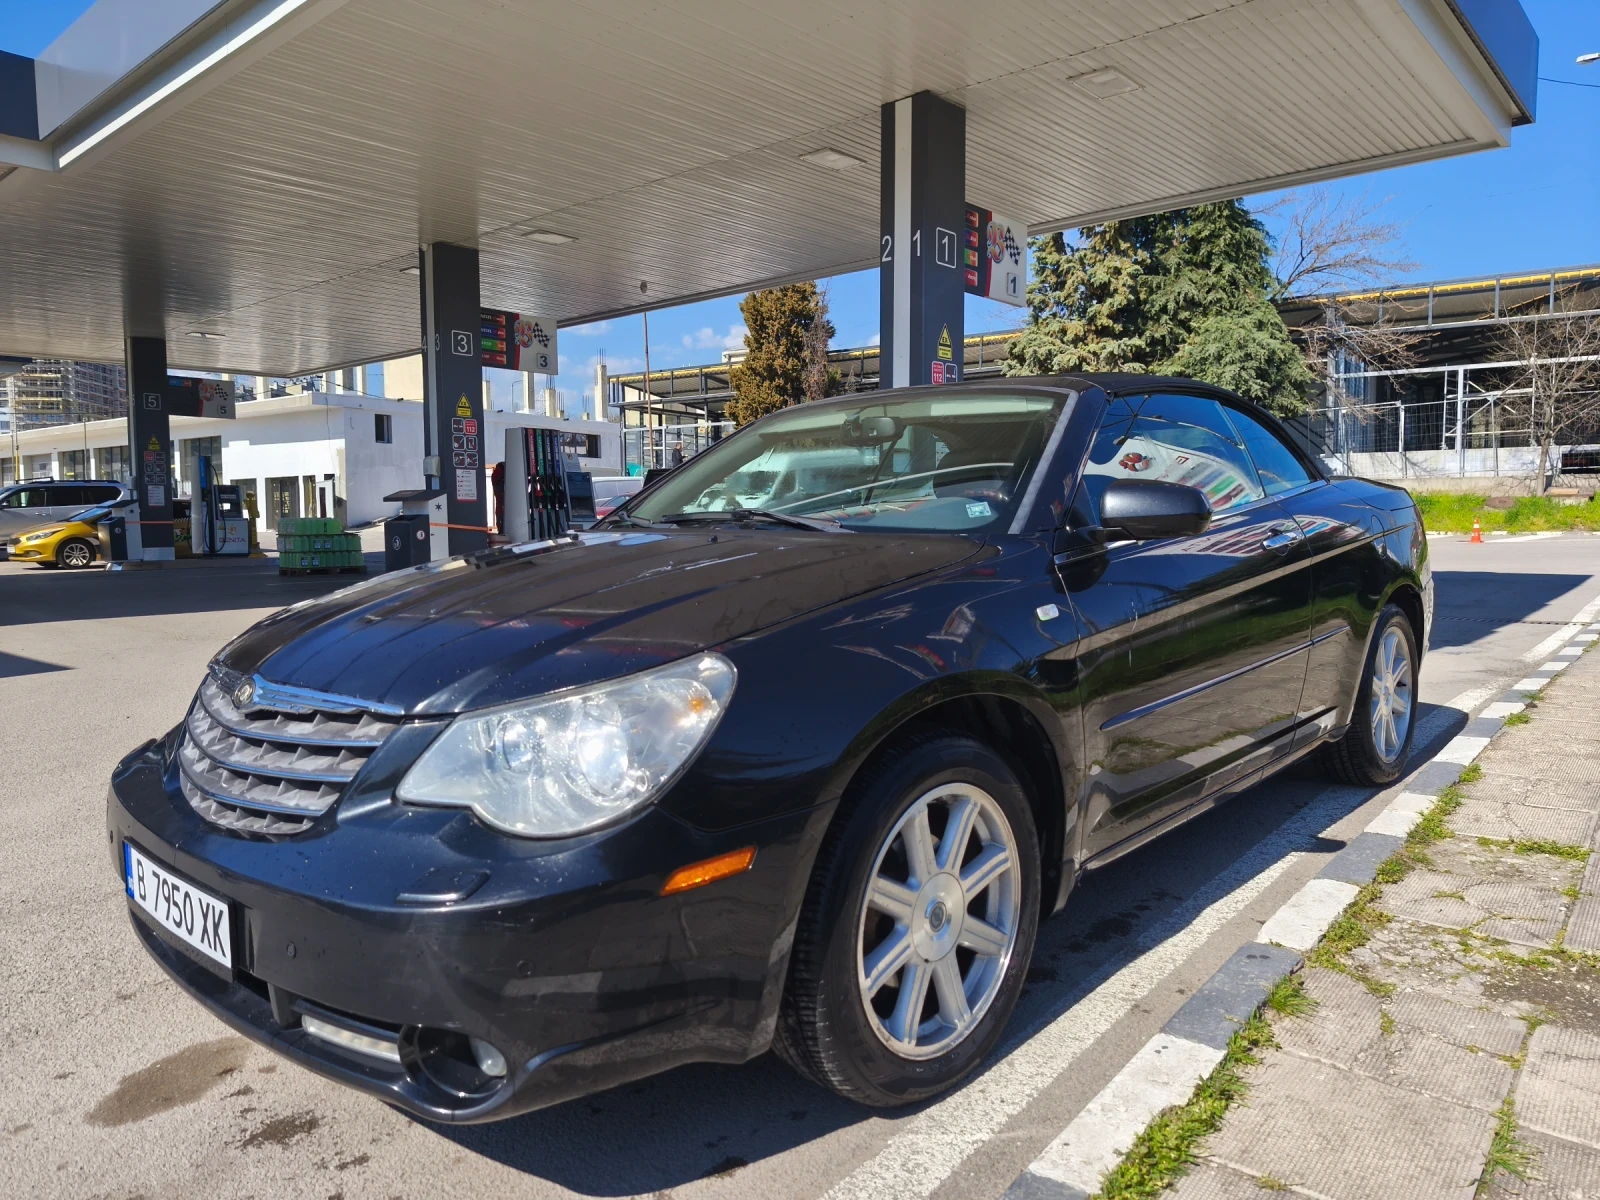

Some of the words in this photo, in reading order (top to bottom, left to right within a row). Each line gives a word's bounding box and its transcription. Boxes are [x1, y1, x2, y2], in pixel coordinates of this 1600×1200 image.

[881, 235, 892, 262] 2
[912, 229, 921, 257] 1
[941, 235, 949, 262] 1
[1010, 276, 1017, 294] 1
[421, 335, 428, 353] 4
[435, 333, 441, 351] 3
[457, 334, 468, 353] 3
[539, 355, 548, 368] 3
[933, 372, 943, 382] 112
[148, 395, 157, 408] 5
[220, 406, 227, 414] 5
[136, 857, 146, 902] B
[152, 869, 194, 936] 7950
[198, 896, 227, 958] XK
